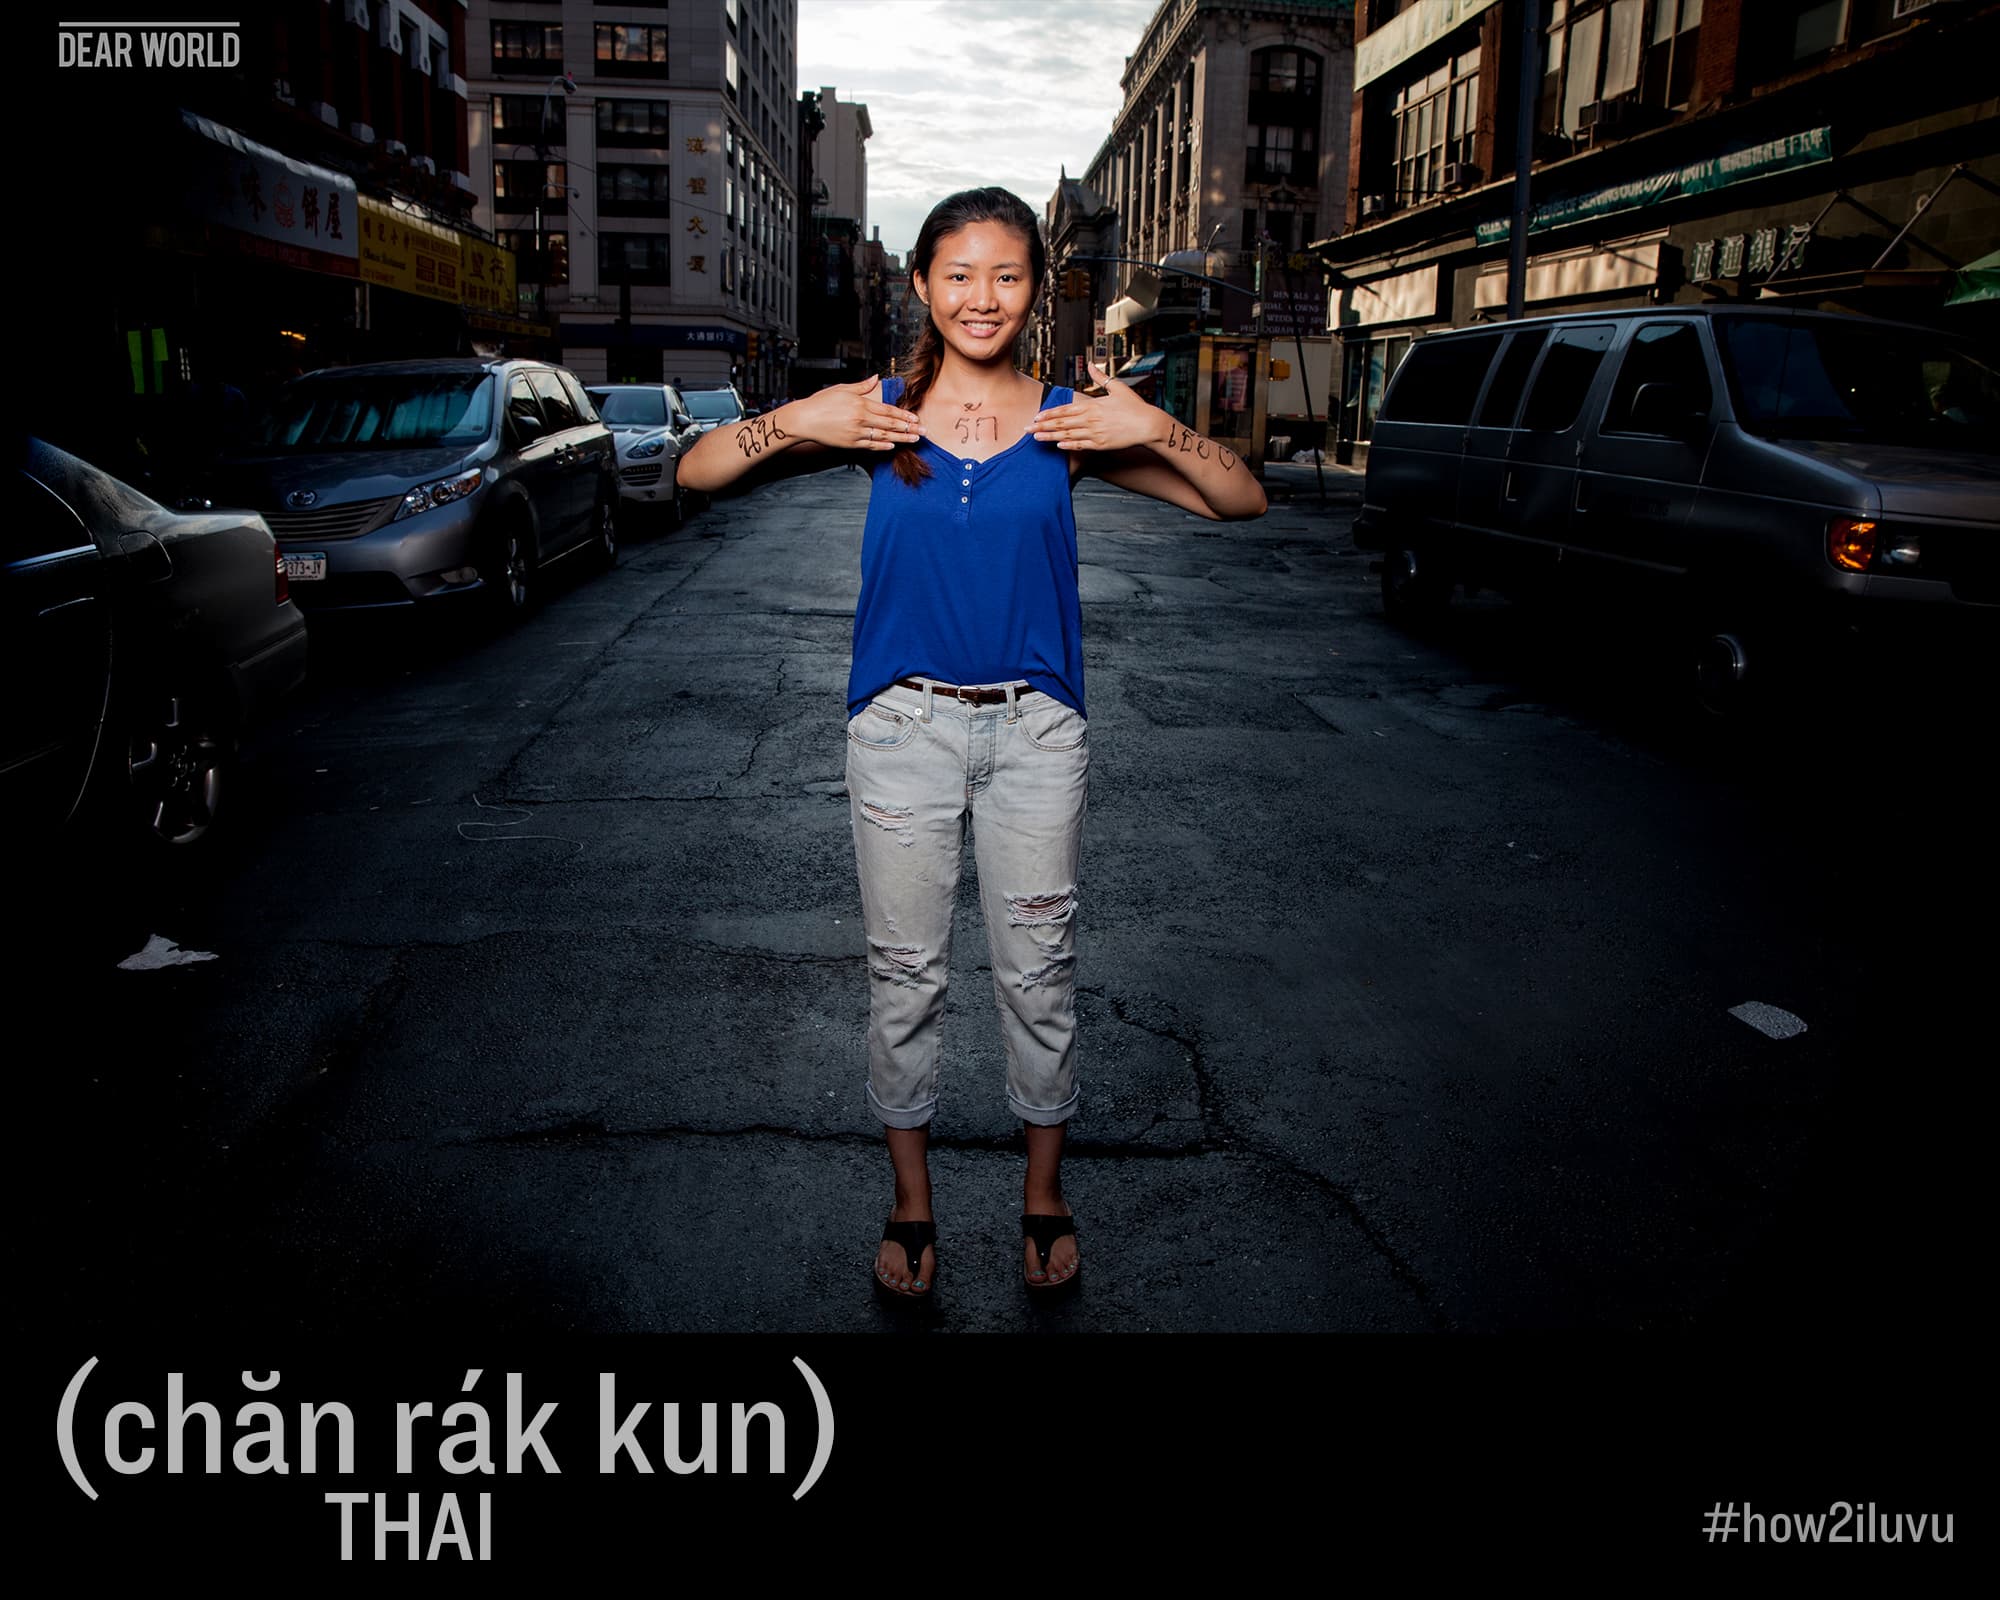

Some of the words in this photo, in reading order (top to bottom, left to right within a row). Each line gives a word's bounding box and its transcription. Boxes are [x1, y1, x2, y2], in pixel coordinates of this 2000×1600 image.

[1273, 290, 1309, 300] RENALS
[1266, 313, 1305, 324] WEDDNG
[1240, 325, 1303, 336] PHOOGRAPY
[954, 402, 998, 444] รัก
